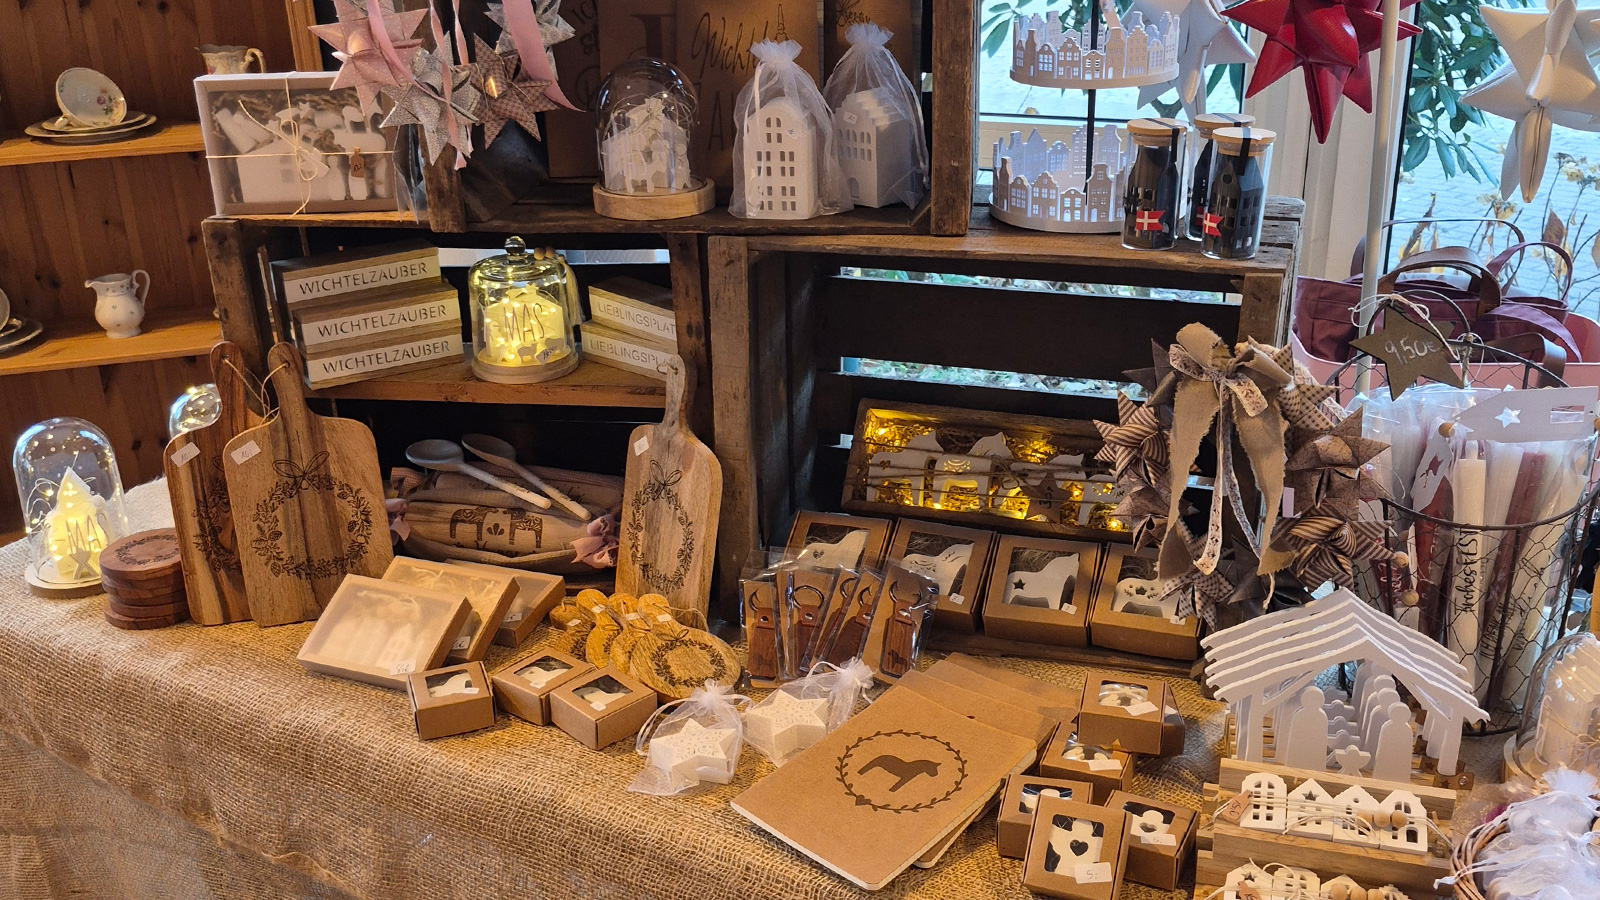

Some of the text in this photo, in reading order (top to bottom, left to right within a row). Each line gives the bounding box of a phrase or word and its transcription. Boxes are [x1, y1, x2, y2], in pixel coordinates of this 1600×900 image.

[299, 262, 428, 295] WICHTELZAUBER
[317, 304, 447, 338] WICHTELZAUBER
[322, 340, 450, 374] WICHTELZAUBER
[1384, 335, 1440, 365] 9,50€
[1454, 568, 1477, 615] Frohes
